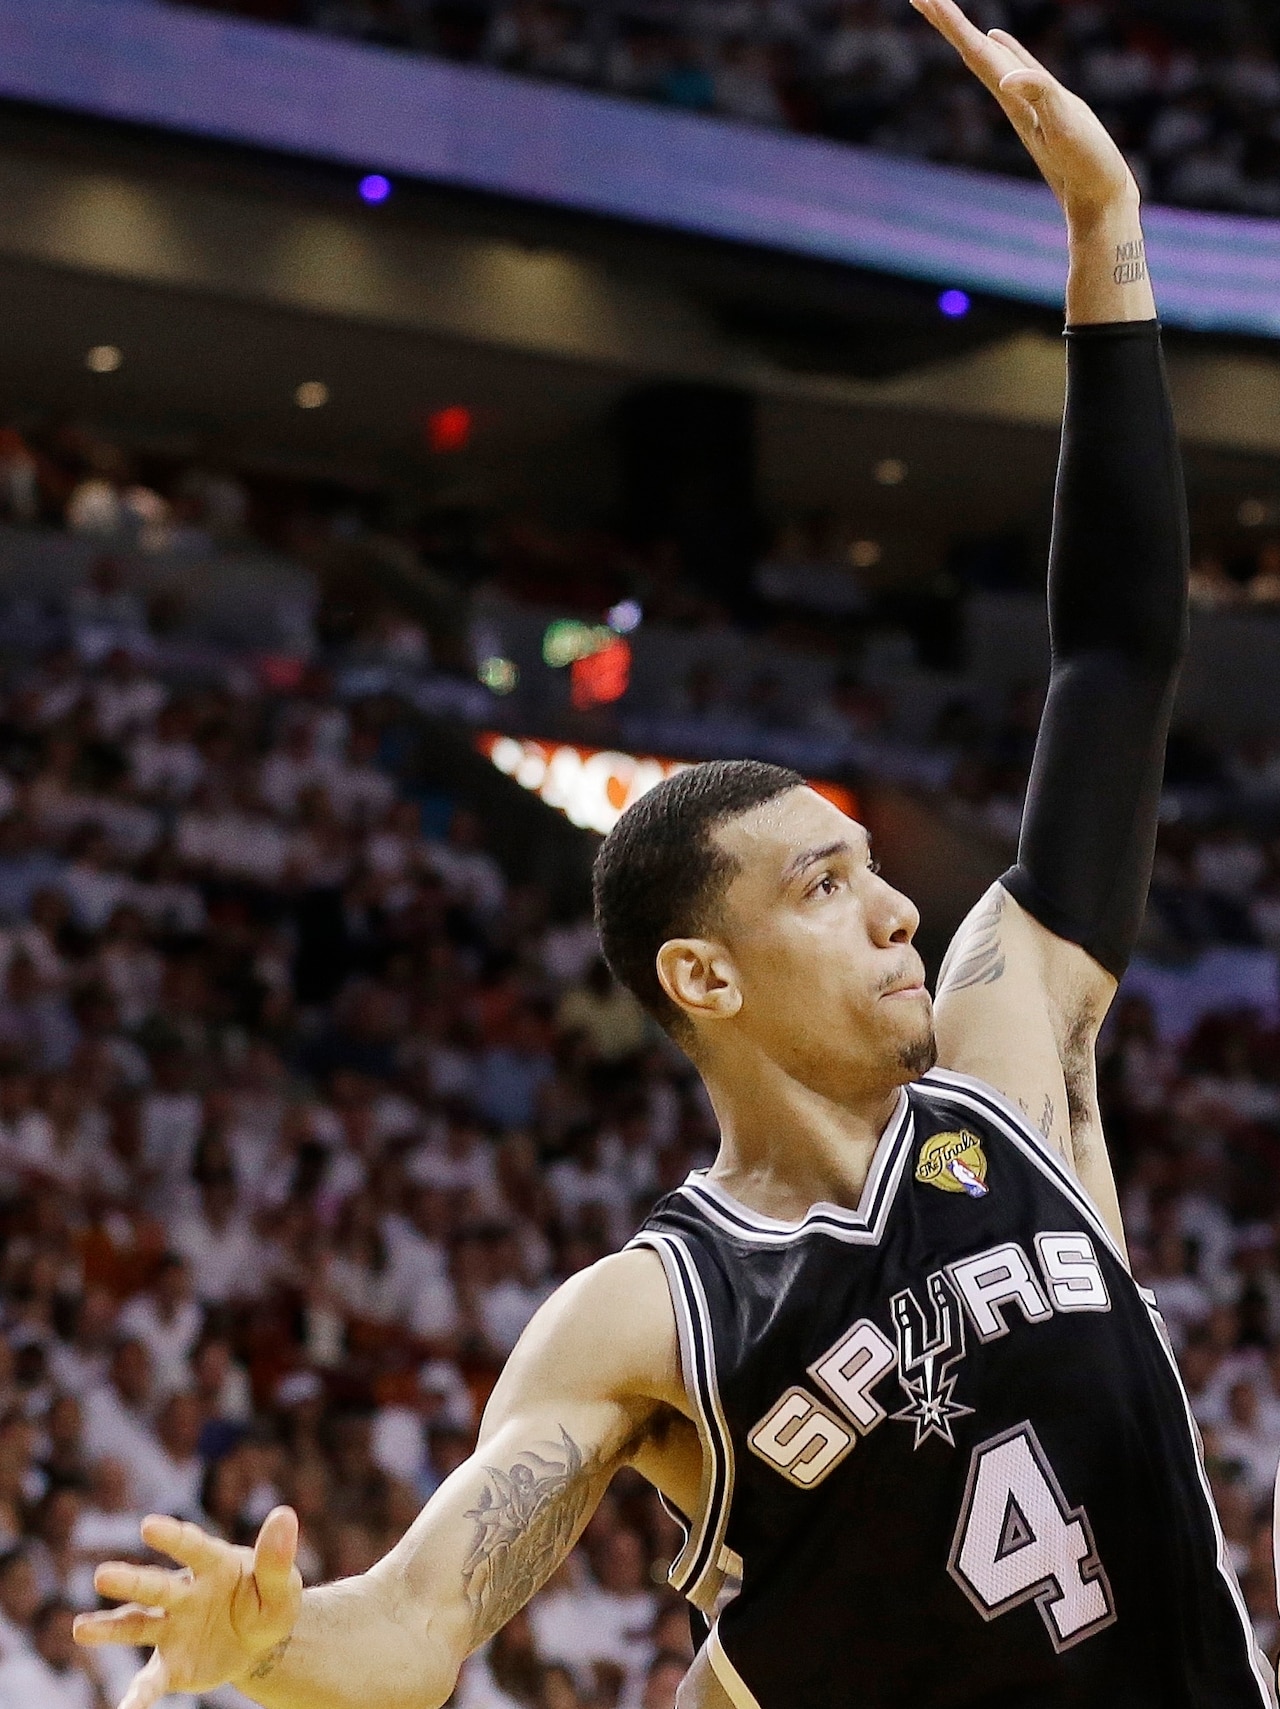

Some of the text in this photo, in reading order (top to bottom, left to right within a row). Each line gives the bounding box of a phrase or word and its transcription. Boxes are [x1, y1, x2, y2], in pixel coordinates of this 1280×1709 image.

[924, 1131, 979, 1179] Finals
[747, 1231, 1112, 1490] SPURS
[946, 1420, 1117, 1654] 4
